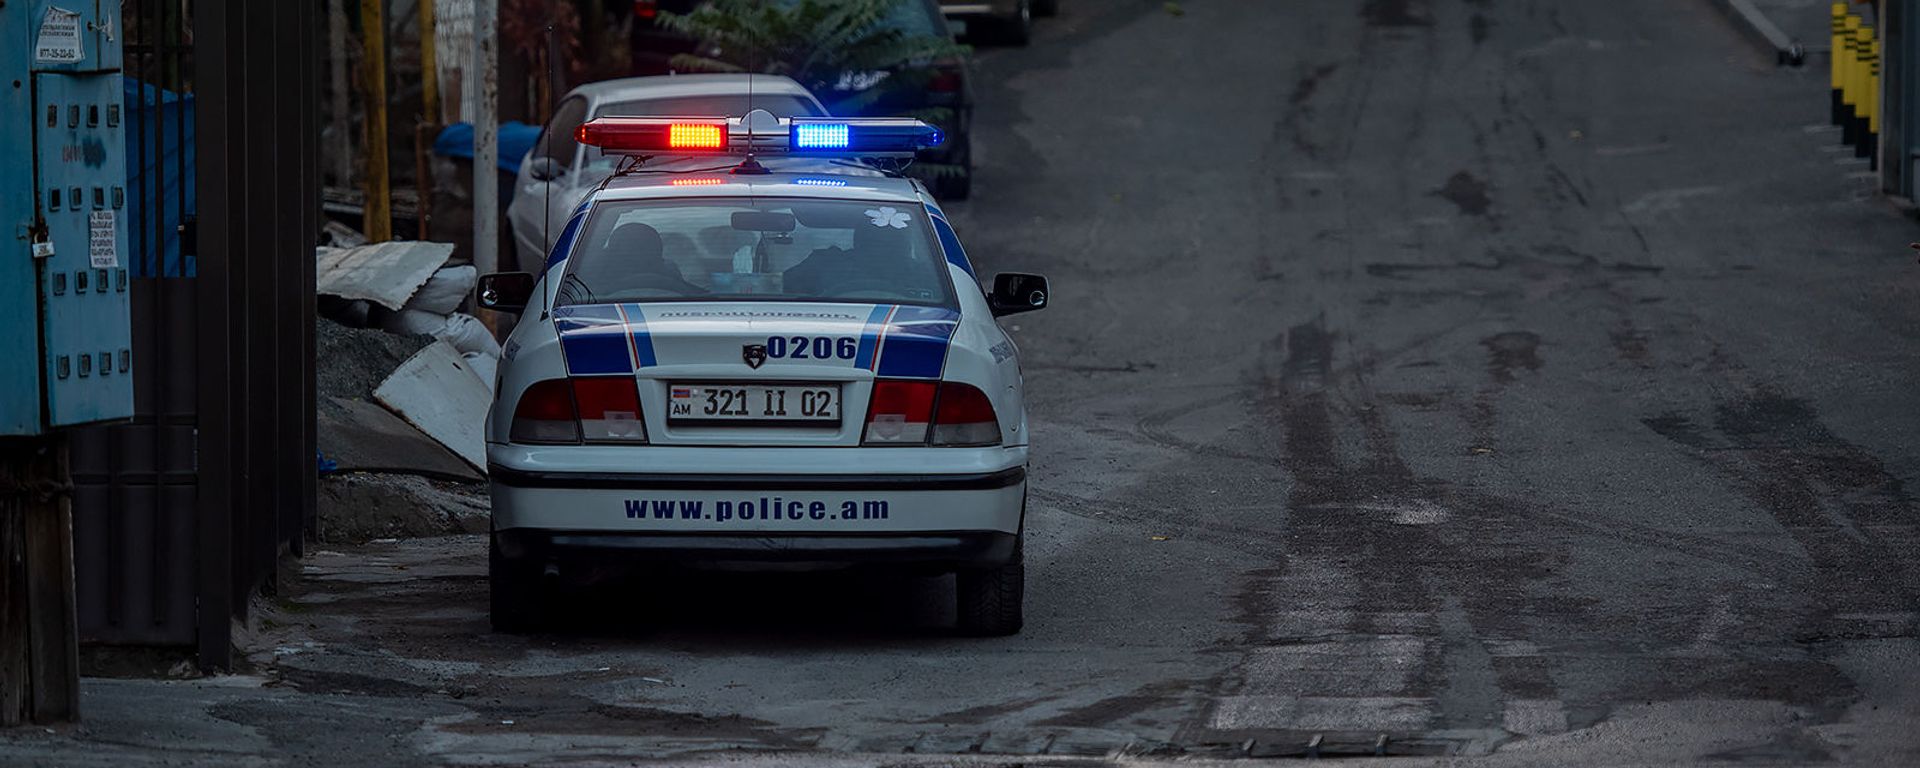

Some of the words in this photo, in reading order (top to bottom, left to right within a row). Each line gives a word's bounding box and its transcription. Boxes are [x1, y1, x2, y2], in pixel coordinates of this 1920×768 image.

[767, 336, 855, 359] 0206
[673, 404, 691, 415] AM
[704, 389, 749, 416] 321
[765, 390, 787, 416] II
[802, 390, 832, 417] 02
[624, 497, 890, 522] www.police.am
